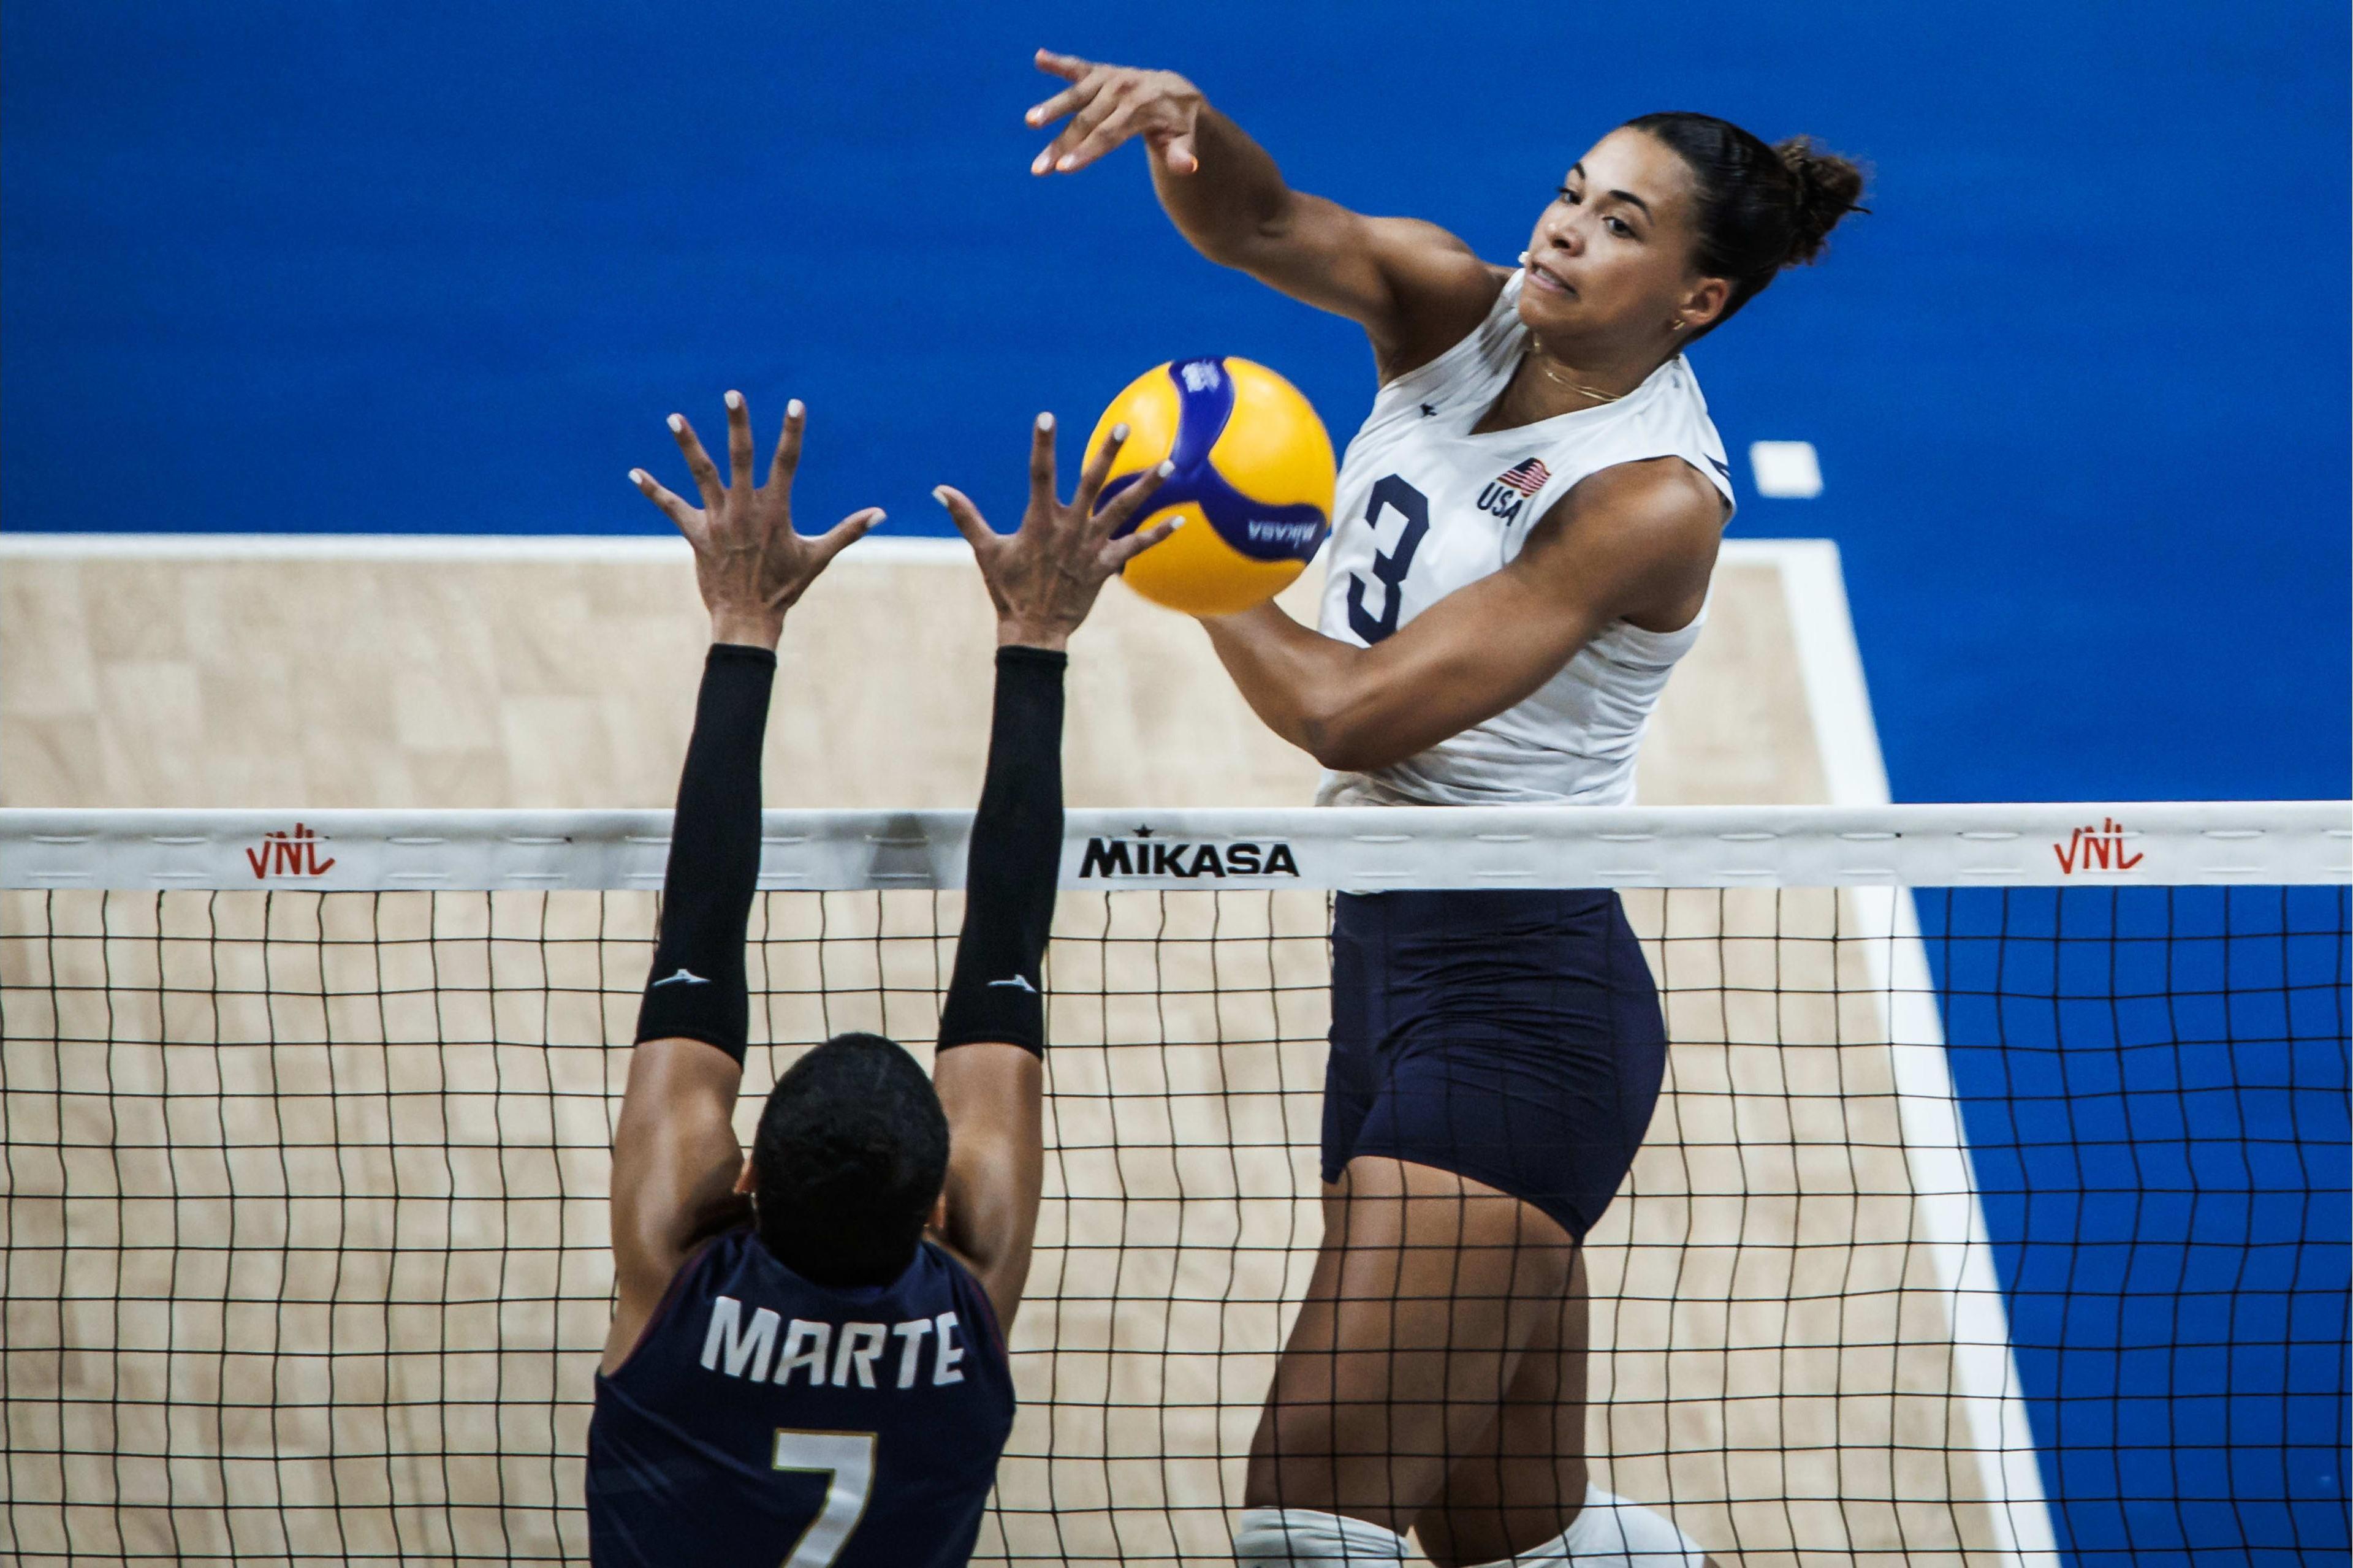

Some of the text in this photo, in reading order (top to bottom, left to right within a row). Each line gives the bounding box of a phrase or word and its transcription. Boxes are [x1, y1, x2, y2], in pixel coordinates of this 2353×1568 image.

[1477, 482, 1523, 527] USA
[1347, 473, 1430, 646] 3
[246, 822, 335, 879] VNL
[1079, 832, 1301, 878] MIKASA
[2053, 817, 2144, 874] VNL
[699, 1295, 965, 1389] MARTE
[770, 1426, 879, 1568] 7
